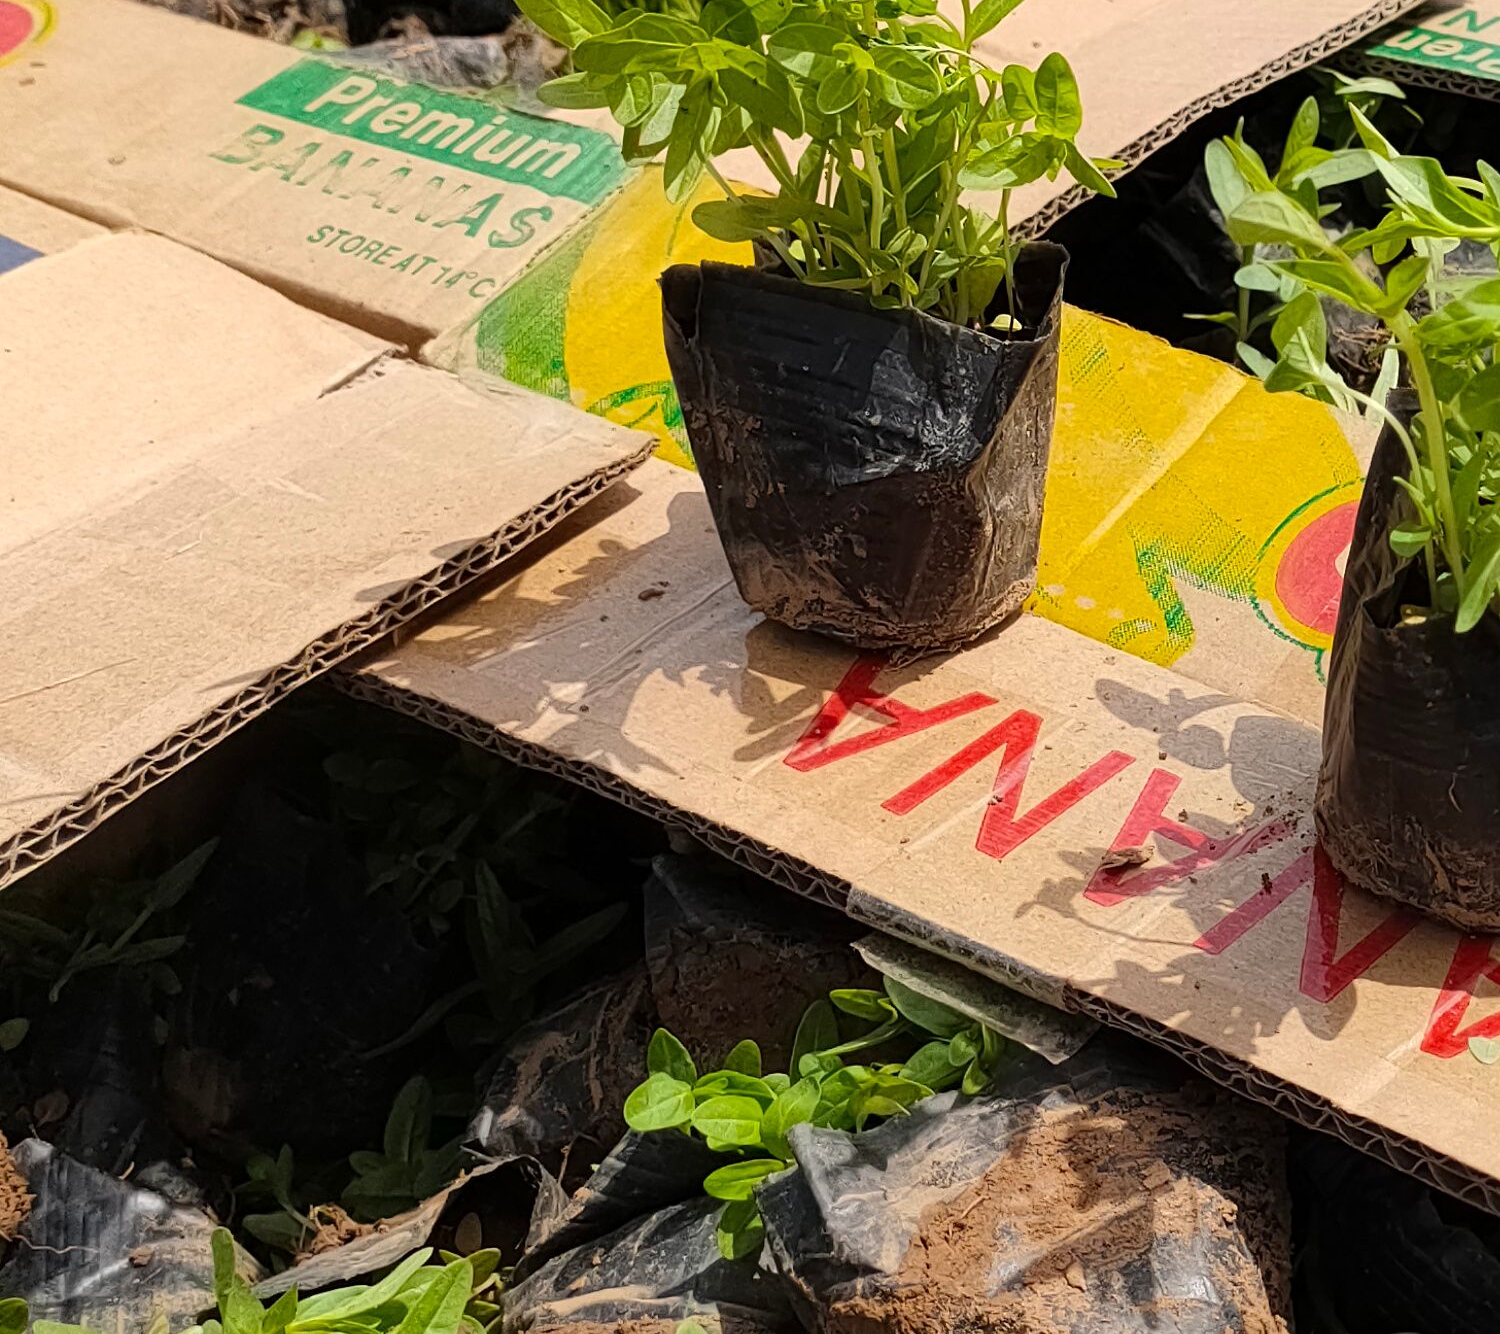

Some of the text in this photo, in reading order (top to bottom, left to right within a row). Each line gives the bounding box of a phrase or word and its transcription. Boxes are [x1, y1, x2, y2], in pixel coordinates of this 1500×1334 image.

[305, 74, 583, 179] Premium
[208, 123, 554, 249] BANANAS
[306, 224, 402, 266] STORE
[395, 255, 438, 276] AT
